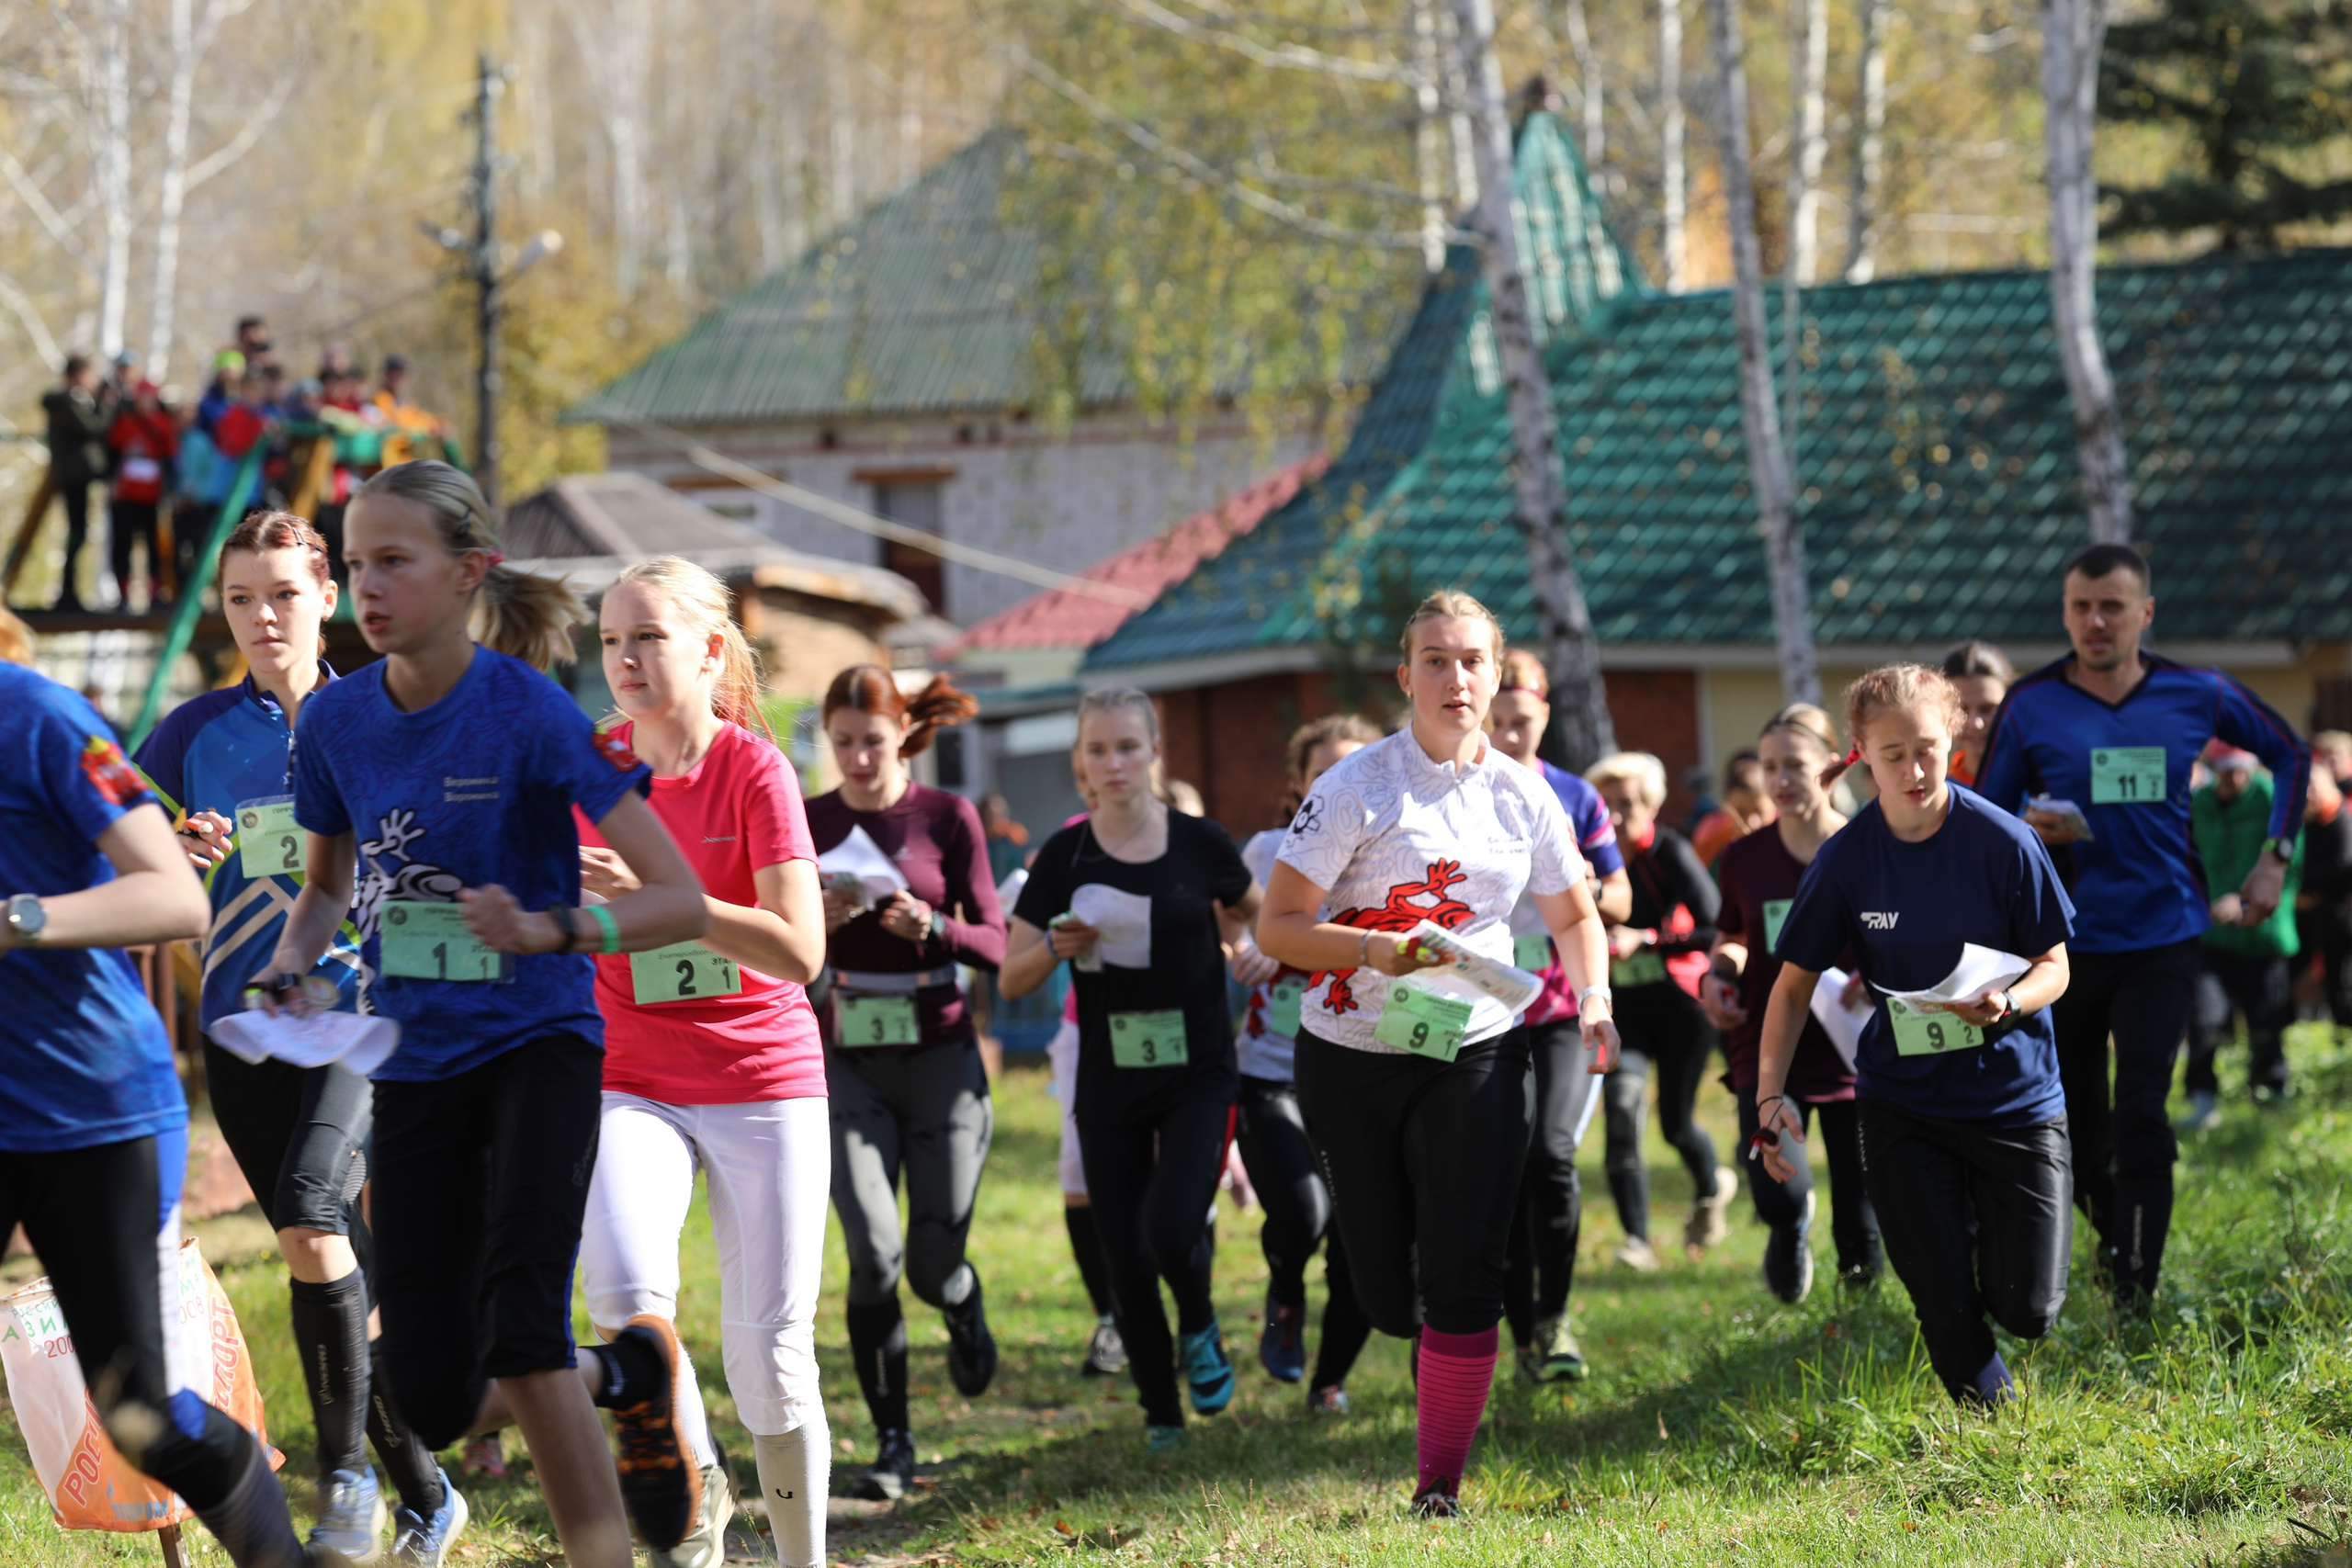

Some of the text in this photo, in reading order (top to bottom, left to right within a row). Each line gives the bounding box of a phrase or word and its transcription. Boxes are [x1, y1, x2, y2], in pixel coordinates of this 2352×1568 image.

[2118, 774, 2136, 797] 11
[281, 835, 300, 869] 2
[1860, 911, 1899, 929] RAY
[432, 942, 447, 980] 1
[480, 956, 488, 980] 1
[676, 960, 696, 996] 2
[722, 966, 730, 989] 1
[871, 1018, 884, 1041] 3
[1409, 1022, 1430, 1049] 9
[1927, 1021, 1945, 1049] 9
[1964, 1025, 1974, 1044] 2
[1142, 1040, 1156, 1063] 3
[1445, 1039, 1454, 1057] 1
[177, 1296, 205, 1324] 008
[44, 1334, 75, 1358] 200
[212, 1294, 242, 1409] СПОРТ
